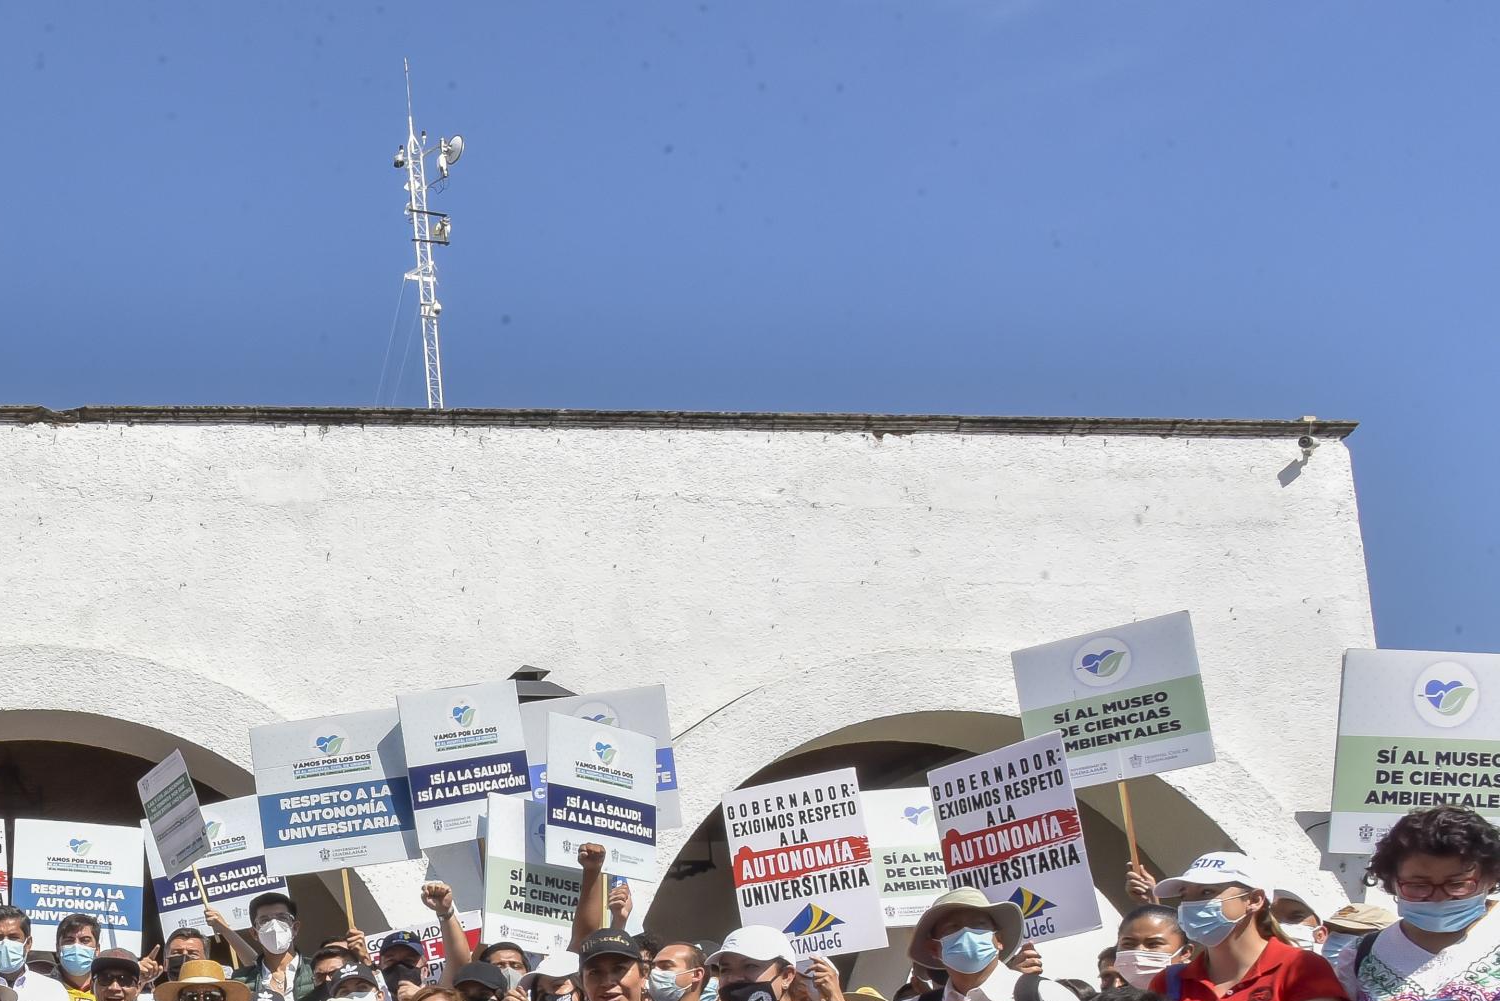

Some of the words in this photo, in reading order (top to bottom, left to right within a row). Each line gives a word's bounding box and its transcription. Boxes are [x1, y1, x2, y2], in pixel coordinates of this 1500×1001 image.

[1054, 706, 1072, 724] SÍ
[1075, 705, 1098, 721] AL
[1103, 692, 1168, 716] MUSEO
[1061, 724, 1082, 738] DE
[1085, 707, 1170, 732] CIENCIAS
[1065, 720, 1181, 752] MBIENTALES
[1377, 746, 1398, 764] SÍ
[1402, 751, 1429, 764] AL
[435, 787, 444, 799] A
[445, 785, 461, 798] LA
[462, 774, 525, 795] EDUCACIÓN!
[447, 770, 456, 781] A
[457, 770, 472, 780] LA
[474, 763, 511, 777] SALUD!
[933, 748, 1061, 801] GOBERNADOR:
[1376, 770, 1404, 784] DE
[1410, 771, 1500, 787] CIENCIAS
[280, 790, 352, 810] RESPETO
[356, 788, 369, 799] A
[371, 784, 391, 798] LA
[728, 783, 855, 820] GOBERNADOR:
[939, 790, 1000, 821] EXIGIMOS
[1004, 769, 1064, 803] RESPETO
[1365, 790, 1500, 808] AMBIENTALE
[290, 799, 387, 824] AUTONOMÍA
[733, 812, 795, 838] EXIGIMOS
[799, 802, 856, 823] RESPETO
[987, 811, 995, 827] A
[998, 807, 1016, 823] LA
[279, 815, 401, 841] UNIVERSITARIA
[781, 832, 788, 846] A
[792, 828, 809, 844] LA
[951, 814, 1063, 866] AUTONOMÍA
[742, 840, 854, 880] AUTONOMÍA
[952, 843, 1080, 891] UNIVERSITARIA
[743, 868, 870, 907] UNIVERSITARIA
